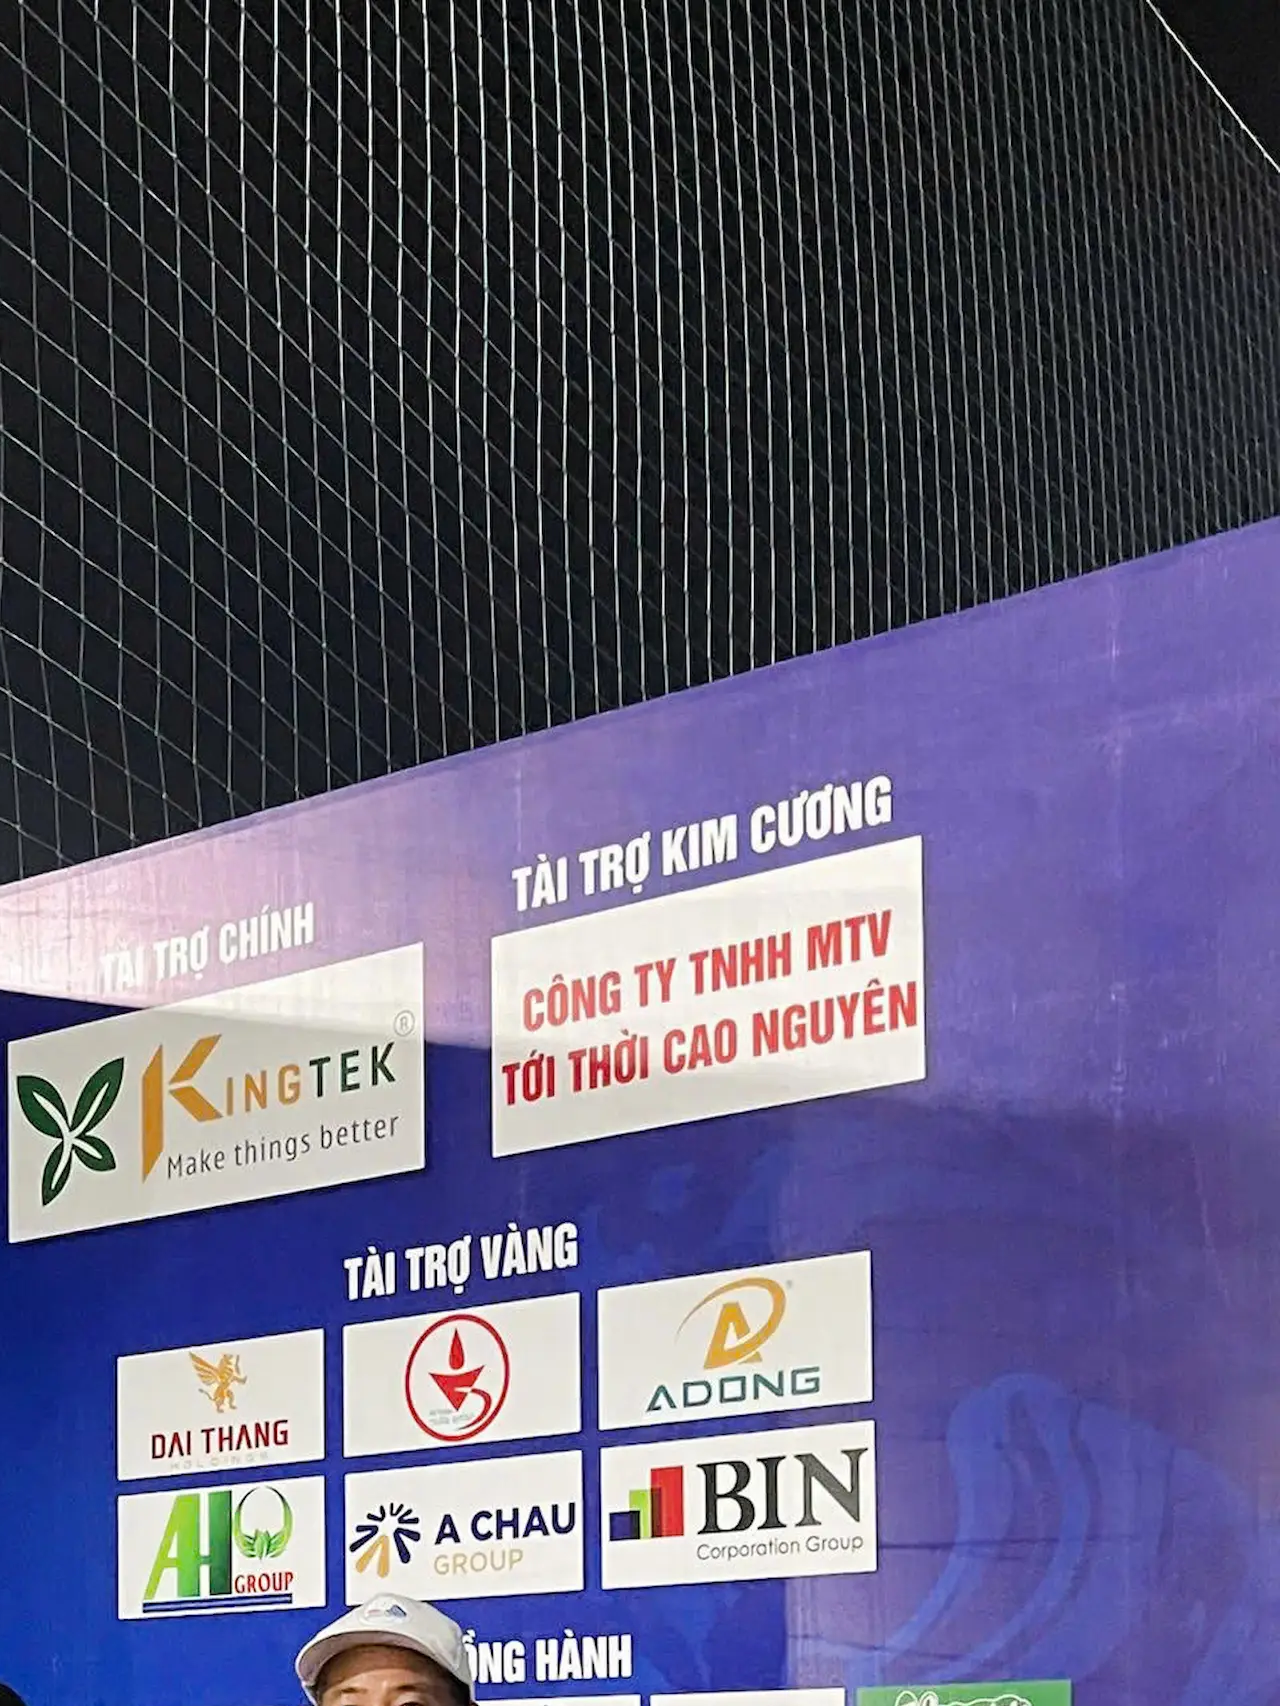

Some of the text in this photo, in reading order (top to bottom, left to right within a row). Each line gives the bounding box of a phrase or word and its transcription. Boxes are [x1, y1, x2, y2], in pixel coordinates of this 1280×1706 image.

[511, 774, 893, 911] TÀI TRỢ KIM CƯƠNG
[153, 925, 210, 981] TRỢ
[219, 901, 314, 964] CHÍNH
[523, 908, 892, 1032] CÔNG TY TNHH MTV
[501, 978, 918, 1106] TỚI THỜI CAO NGUYÊN
[141, 1033, 396, 1184] KINGTEK
[166, 1115, 400, 1180] Make things better
[343, 1222, 579, 1301] TÀI TRỢ VÀNG
[646, 1366, 821, 1413] ADONG
[151, 1419, 289, 1460] DAI THANG
[434, 1502, 577, 1546] A CHAU
[696, 1448, 869, 1536] BIN
[434, 1549, 525, 1576] GROUP
[696, 1535, 864, 1562] Corporation Group
[234, 1571, 294, 1595] GROUP
[535, 1628, 632, 1682] HÀNH
